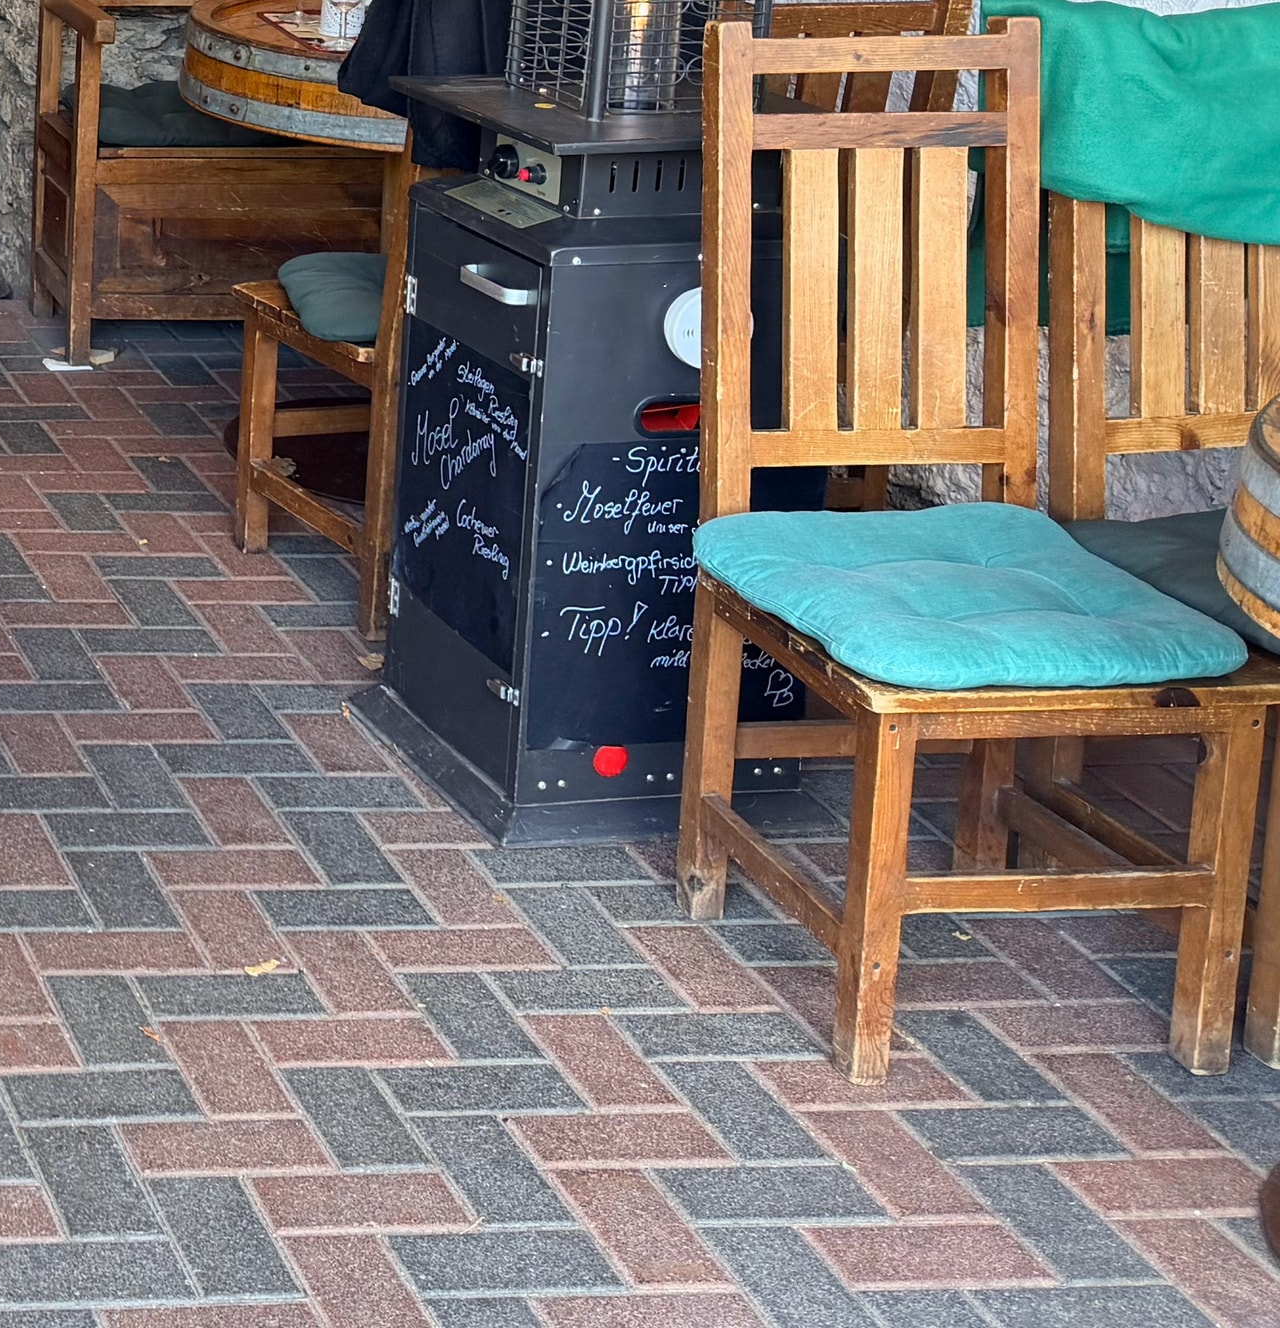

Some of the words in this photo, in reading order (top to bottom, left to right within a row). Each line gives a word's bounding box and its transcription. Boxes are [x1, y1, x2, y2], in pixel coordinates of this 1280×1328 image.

[411, 397, 459, 466] Mosel
[563, 480, 684, 535] Moselfeuer
[647, 520, 688, 534] unser
[559, 600, 649, 657] Tipp!
[650, 649, 688, 669] mild
